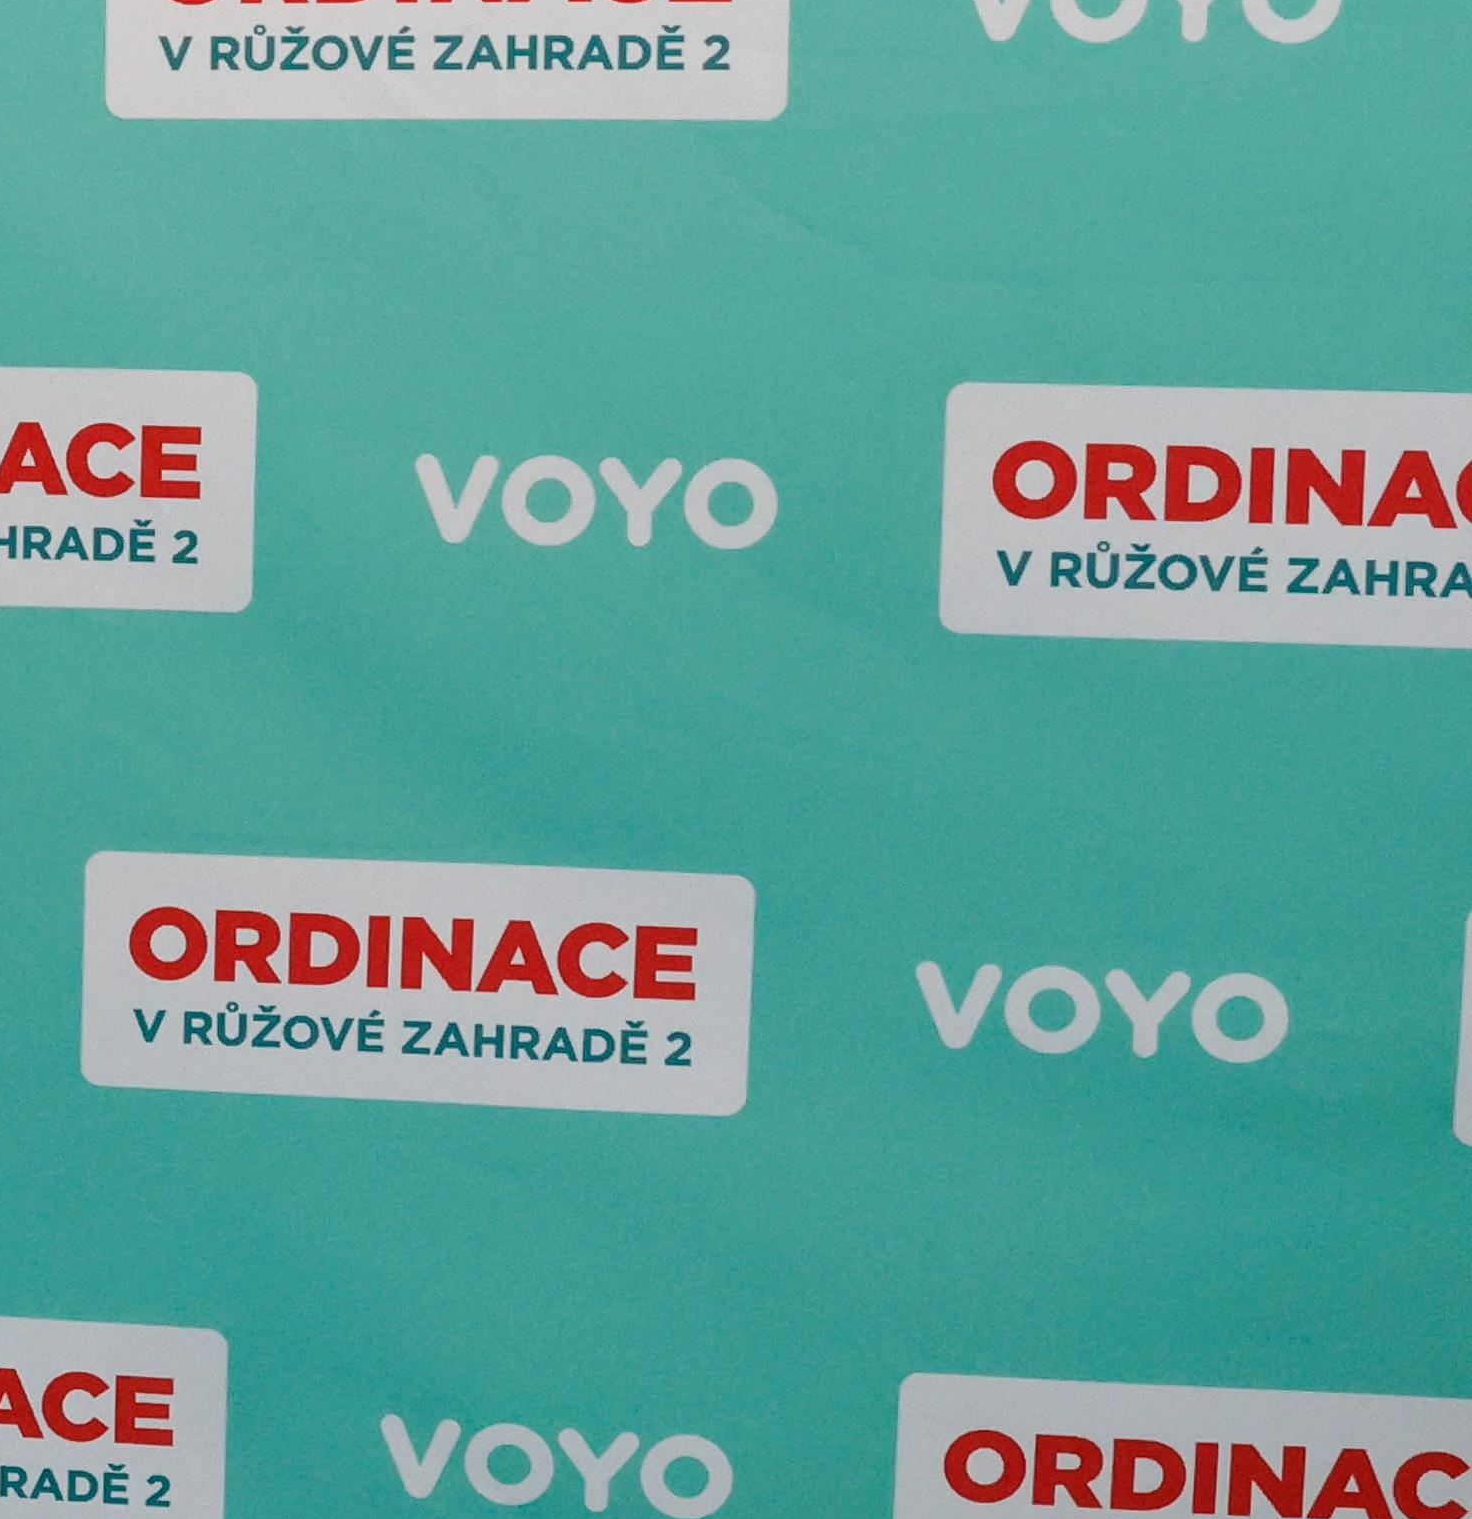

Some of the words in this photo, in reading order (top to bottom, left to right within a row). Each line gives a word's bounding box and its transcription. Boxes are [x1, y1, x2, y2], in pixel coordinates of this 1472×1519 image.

[159, 34, 193, 71] V
[210, 23, 416, 73] RŮŽOVÉ
[433, 23, 685, 72] ZAHRADĚ
[702, 33, 731, 72] 2
[415, 453, 778, 549] VOYO
[130, 907, 697, 1000] ORDINACE
[133, 1007, 167, 1044] V
[182, 1000, 386, 1054] RŮŽOVÉ
[401, 1018, 650, 1066] ZAHRADĚ
[663, 1030, 693, 1068] 2
[916, 961, 1290, 1063] VOYO
[381, 1414, 734, 1519] VOYO
